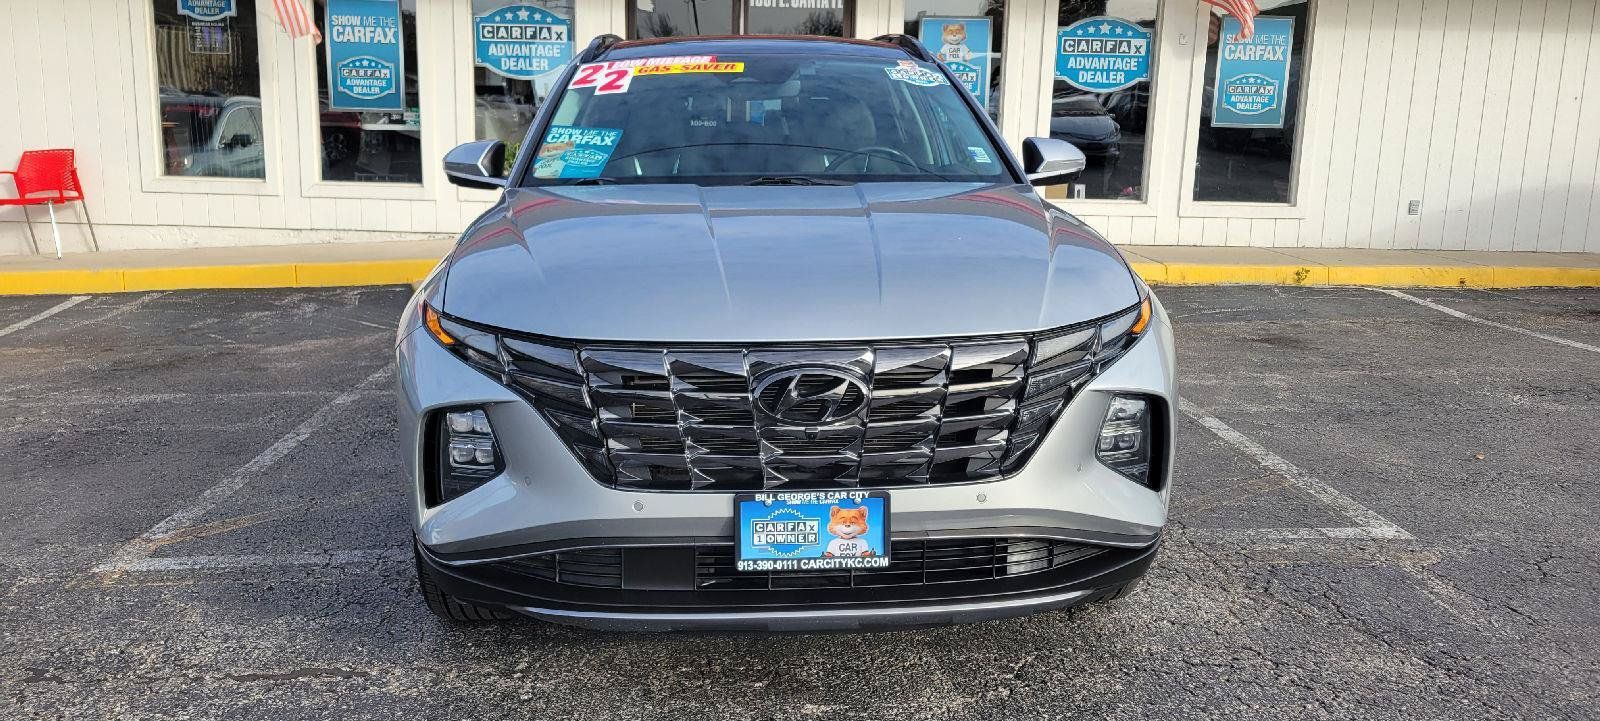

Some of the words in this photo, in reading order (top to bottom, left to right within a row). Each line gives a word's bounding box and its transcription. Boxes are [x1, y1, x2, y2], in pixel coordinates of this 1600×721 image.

[331, 15, 361, 26] SHOW
[363, 16, 377, 27] ME
[380, 16, 396, 28] THE
[332, 26, 397, 44] CARFAX
[482, 25, 565, 41] CARFAX
[1255, 34, 1269, 44] ME
[1270, 35, 1286, 45] THE
[488, 43, 561, 57] ADVANTAGE
[1063, 39, 1144, 54] CARFAX
[1225, 45, 1285, 60] CARFAX
[501, 58, 549, 71] DEALER
[1067, 57, 1138, 70] ADVANTAGE
[342, 68, 390, 78] CARFAX
[1078, 71, 1125, 83] DEALER
[353, 86, 380, 94] DEALER
[1229, 86, 1274, 95] CARFAX
[1230, 95, 1269, 103] ADVANTAGE
[550, 127, 583, 136] SHOW
[546, 133, 616, 146] CARFAX
[755, 494, 775, 502] BILL
[777, 492, 825, 501] GEORGE'S
[828, 492, 848, 500] CAR
[849, 491, 870, 499] CITY
[755, 521, 816, 532] CARFAX
[838, 543, 858, 552] CAR
[738, 560, 798, 571] 913-390-0111
[801, 557, 889, 570] CARCITYKC.COM
